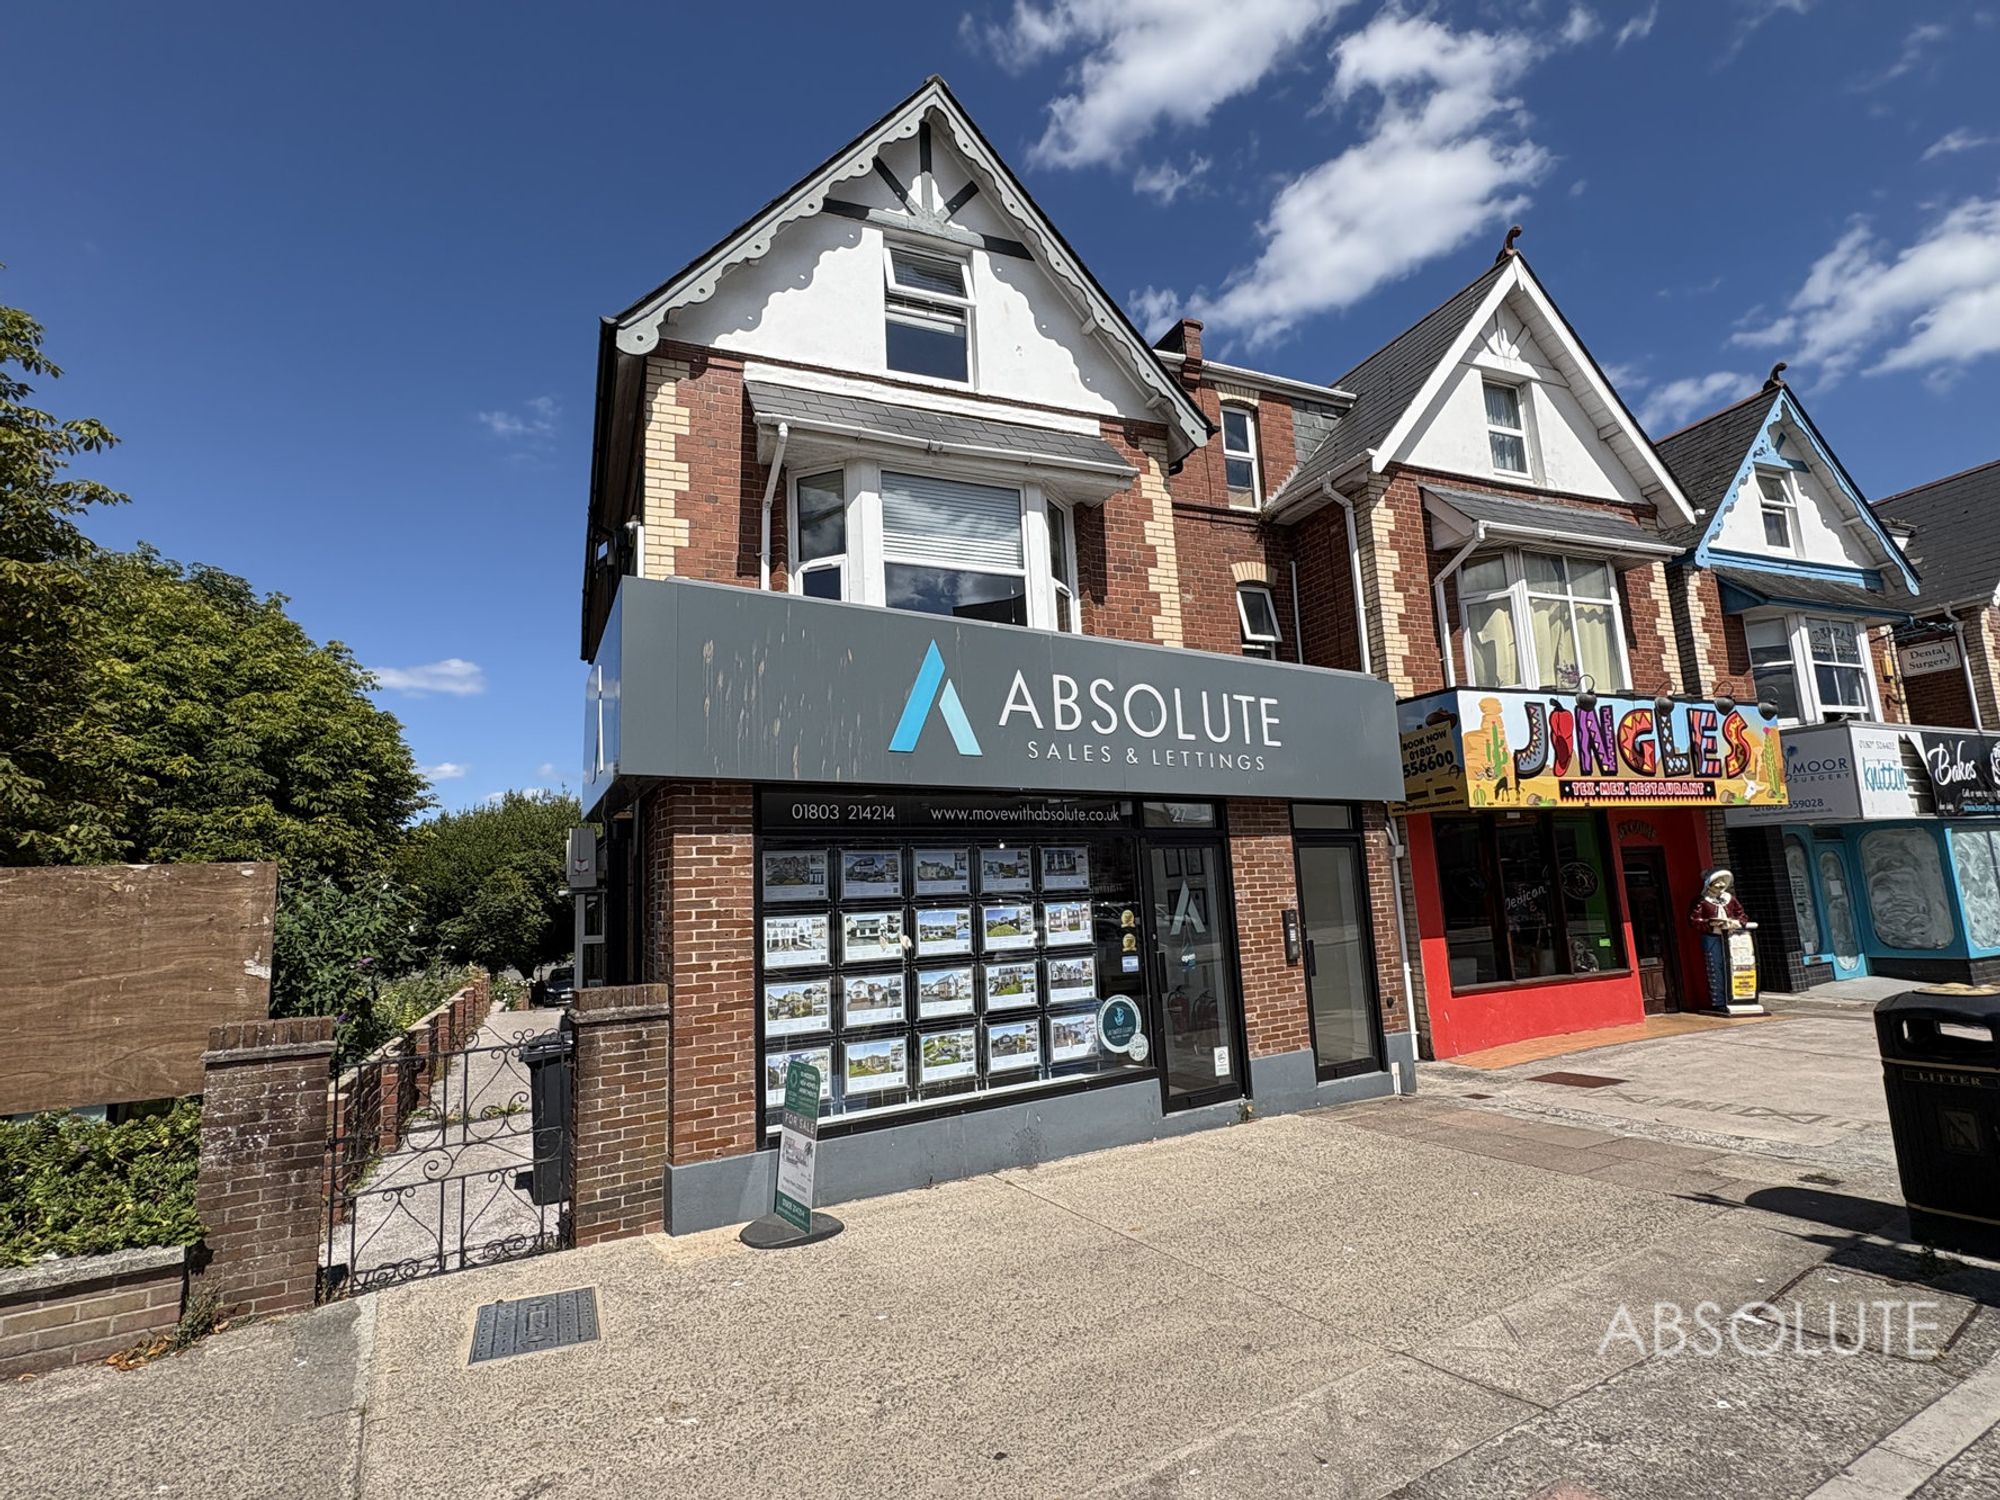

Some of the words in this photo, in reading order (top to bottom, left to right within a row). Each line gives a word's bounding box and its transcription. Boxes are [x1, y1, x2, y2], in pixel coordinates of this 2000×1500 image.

[1909, 645, 1947, 660] Dental
[1908, 656, 1951, 670] Surgery
[998, 669, 1282, 747] ABSOLUTE
[1403, 737, 1427, 751] BOOK
[1426, 730, 1447, 743] NOW
[1514, 698, 1751, 780] JINGLES
[1028, 741, 1112, 763] SALES
[1126, 747, 1139, 765] &
[1152, 748, 1265, 771] LETTINGS
[1409, 745, 1436, 760] 01803
[1403, 750, 1454, 778] 556600
[1927, 740, 1977, 786] Bakes
[1793, 773, 1850, 784] SURGERY
[1572, 782, 1595, 795] TEX
[1600, 782, 1626, 796] MEX
[1629, 782, 1704, 795] RESTAURANT
[792, 803, 840, 820] 01803
[847, 804, 896, 821] 214214
[930, 803, 1120, 822] www.movewithabsolute.co.uk
[1171, 807, 1187, 823] 27
[1919, 1072, 1981, 1086] LITTER
[785, 1112, 797, 1126] FOR
[799, 1118, 815, 1135] SALE
